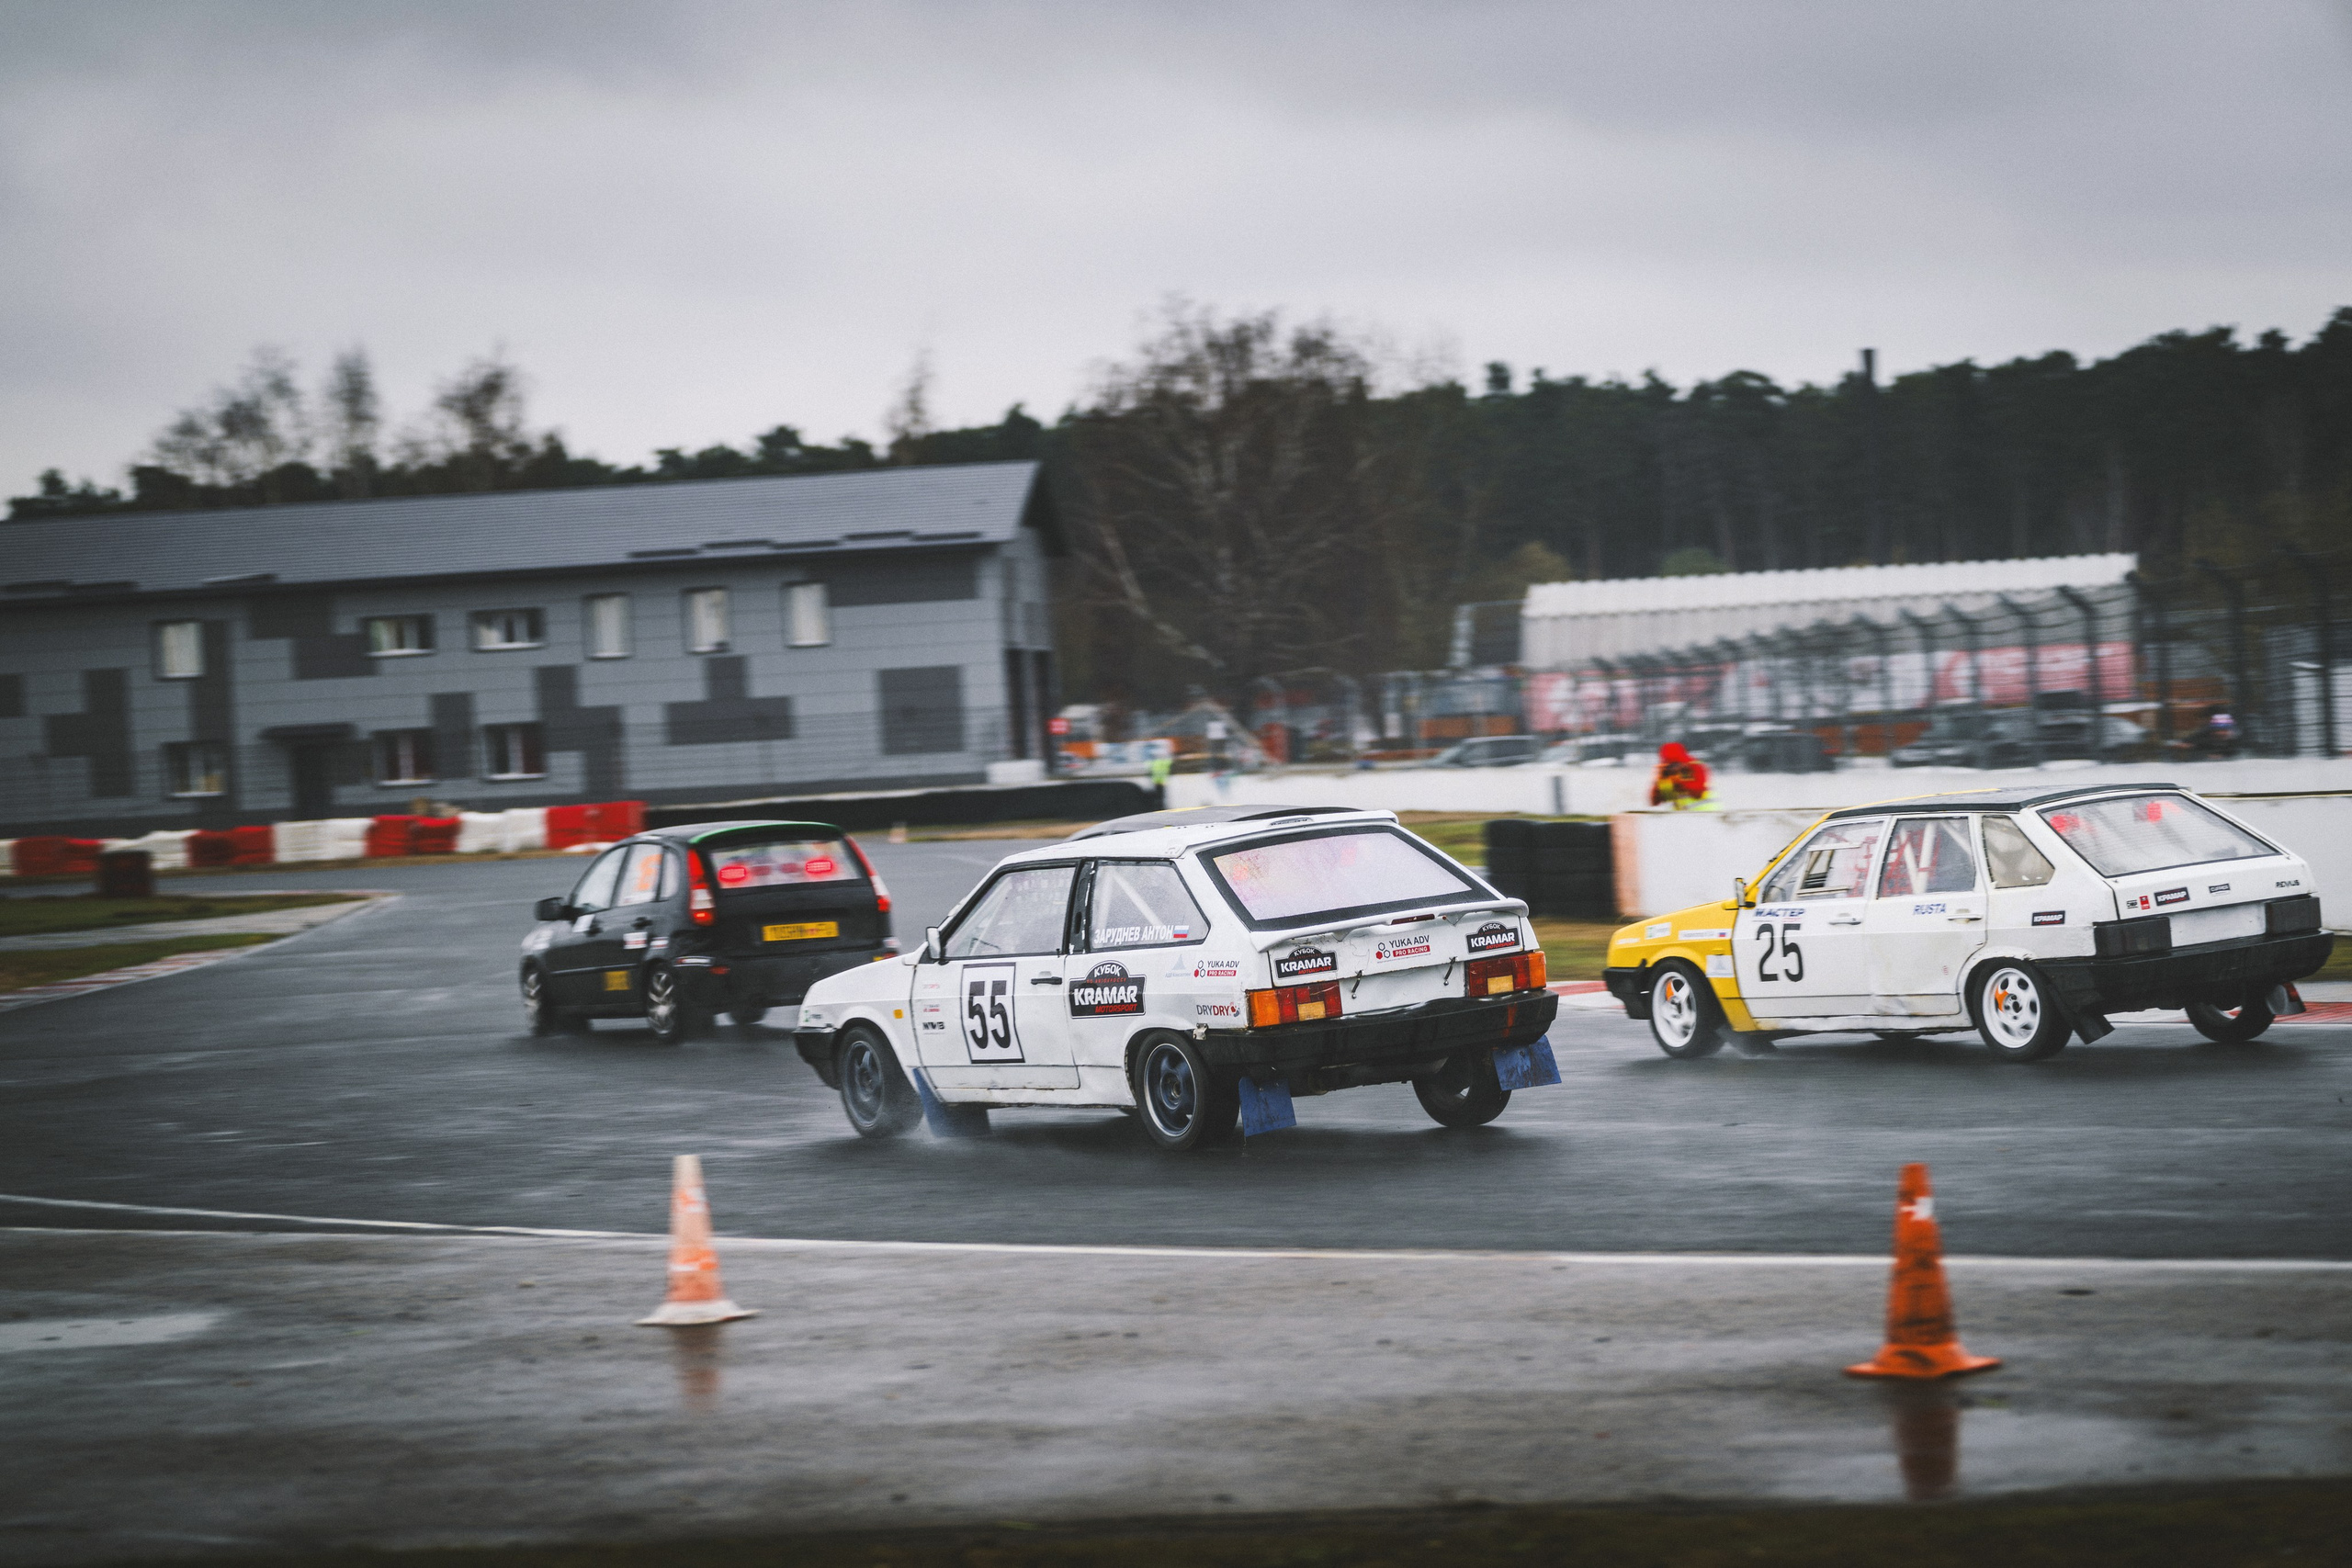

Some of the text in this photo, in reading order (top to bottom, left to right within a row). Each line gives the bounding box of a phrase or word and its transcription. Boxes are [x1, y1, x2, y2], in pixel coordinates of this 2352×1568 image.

[1913, 903, 1947, 916] RUSTA
[1093, 924, 1174, 945] ЗАРУДНЕВ АНТОН
[1388, 934, 1430, 949] YUKA ADV
[1470, 931, 1516, 948] KRAMAR
[1407, 945, 1428, 954] RACING
[1755, 923, 1804, 983] 25
[1093, 964, 1123, 978] КУБОК
[1207, 960, 1240, 969] YUKA ADV
[1280, 956, 1332, 973] KRAMAR
[1073, 985, 1138, 1006] KRAMAR
[967, 980, 1012, 1050] 55
[1094, 1003, 1138, 1014] MOTORSPORT
